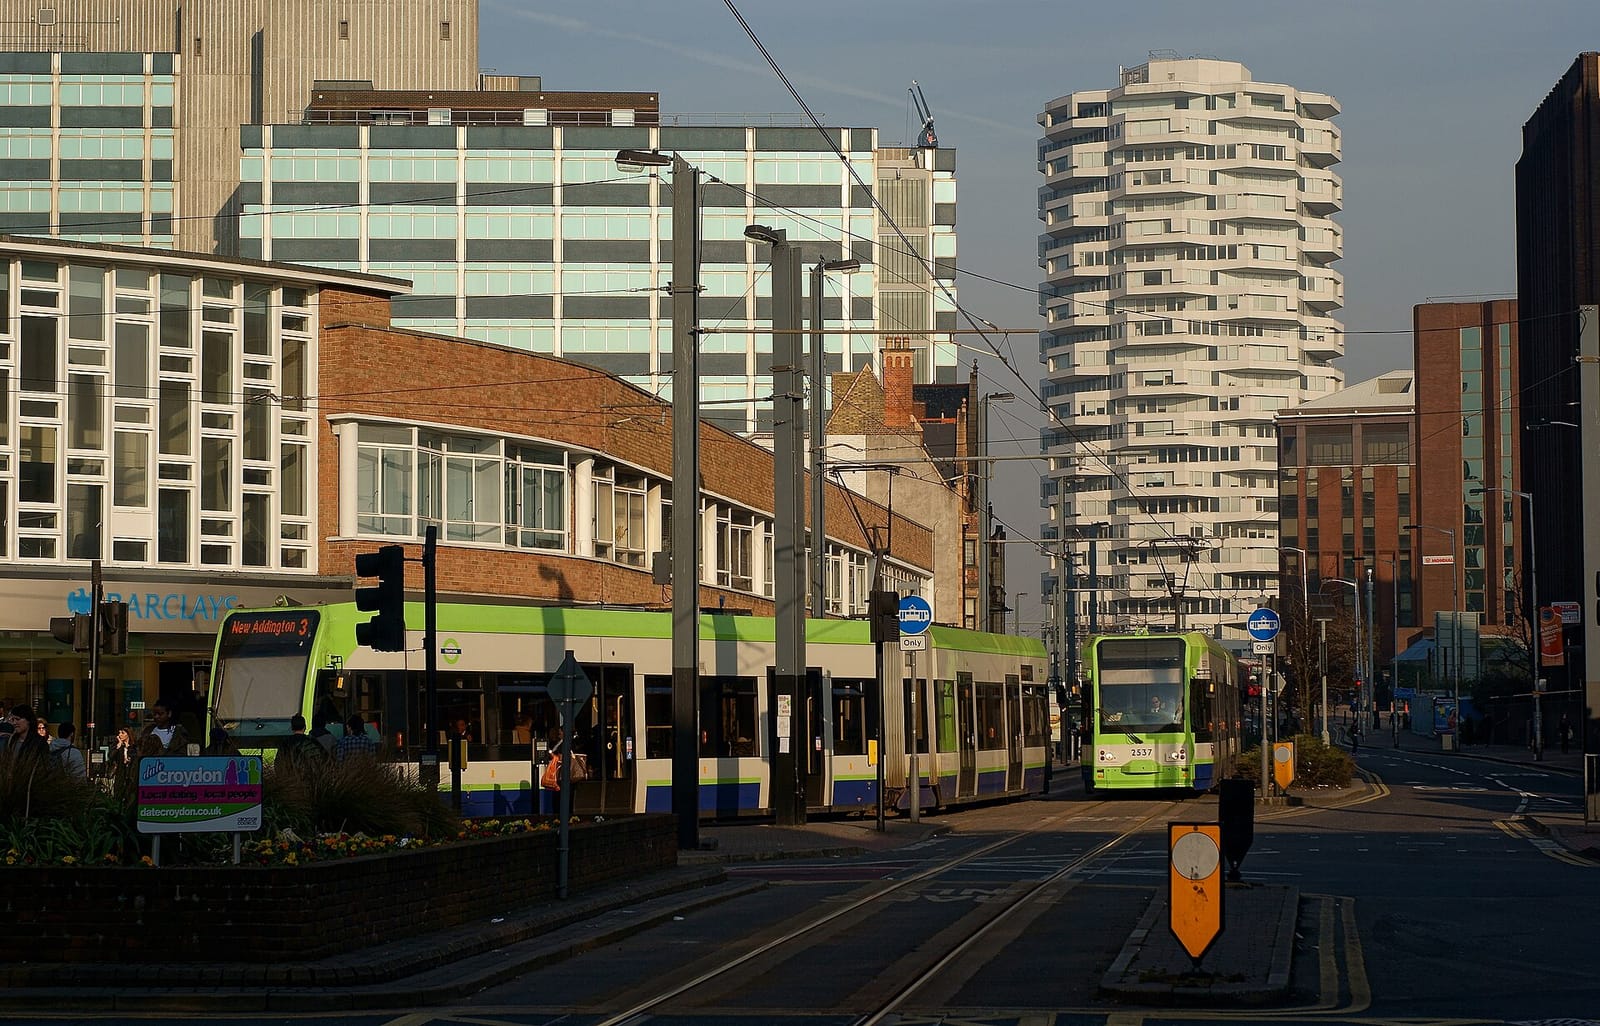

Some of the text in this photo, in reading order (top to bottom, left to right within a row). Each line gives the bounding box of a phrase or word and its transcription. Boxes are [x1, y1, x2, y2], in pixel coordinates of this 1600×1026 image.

[232, 619, 308, 636] New Addington 3
[903, 639, 921, 647] Only
[1131, 748, 1152, 756] 2537
[157, 767, 222, 787] croydon
[140, 805, 222, 818] datecroydon.co.uk
